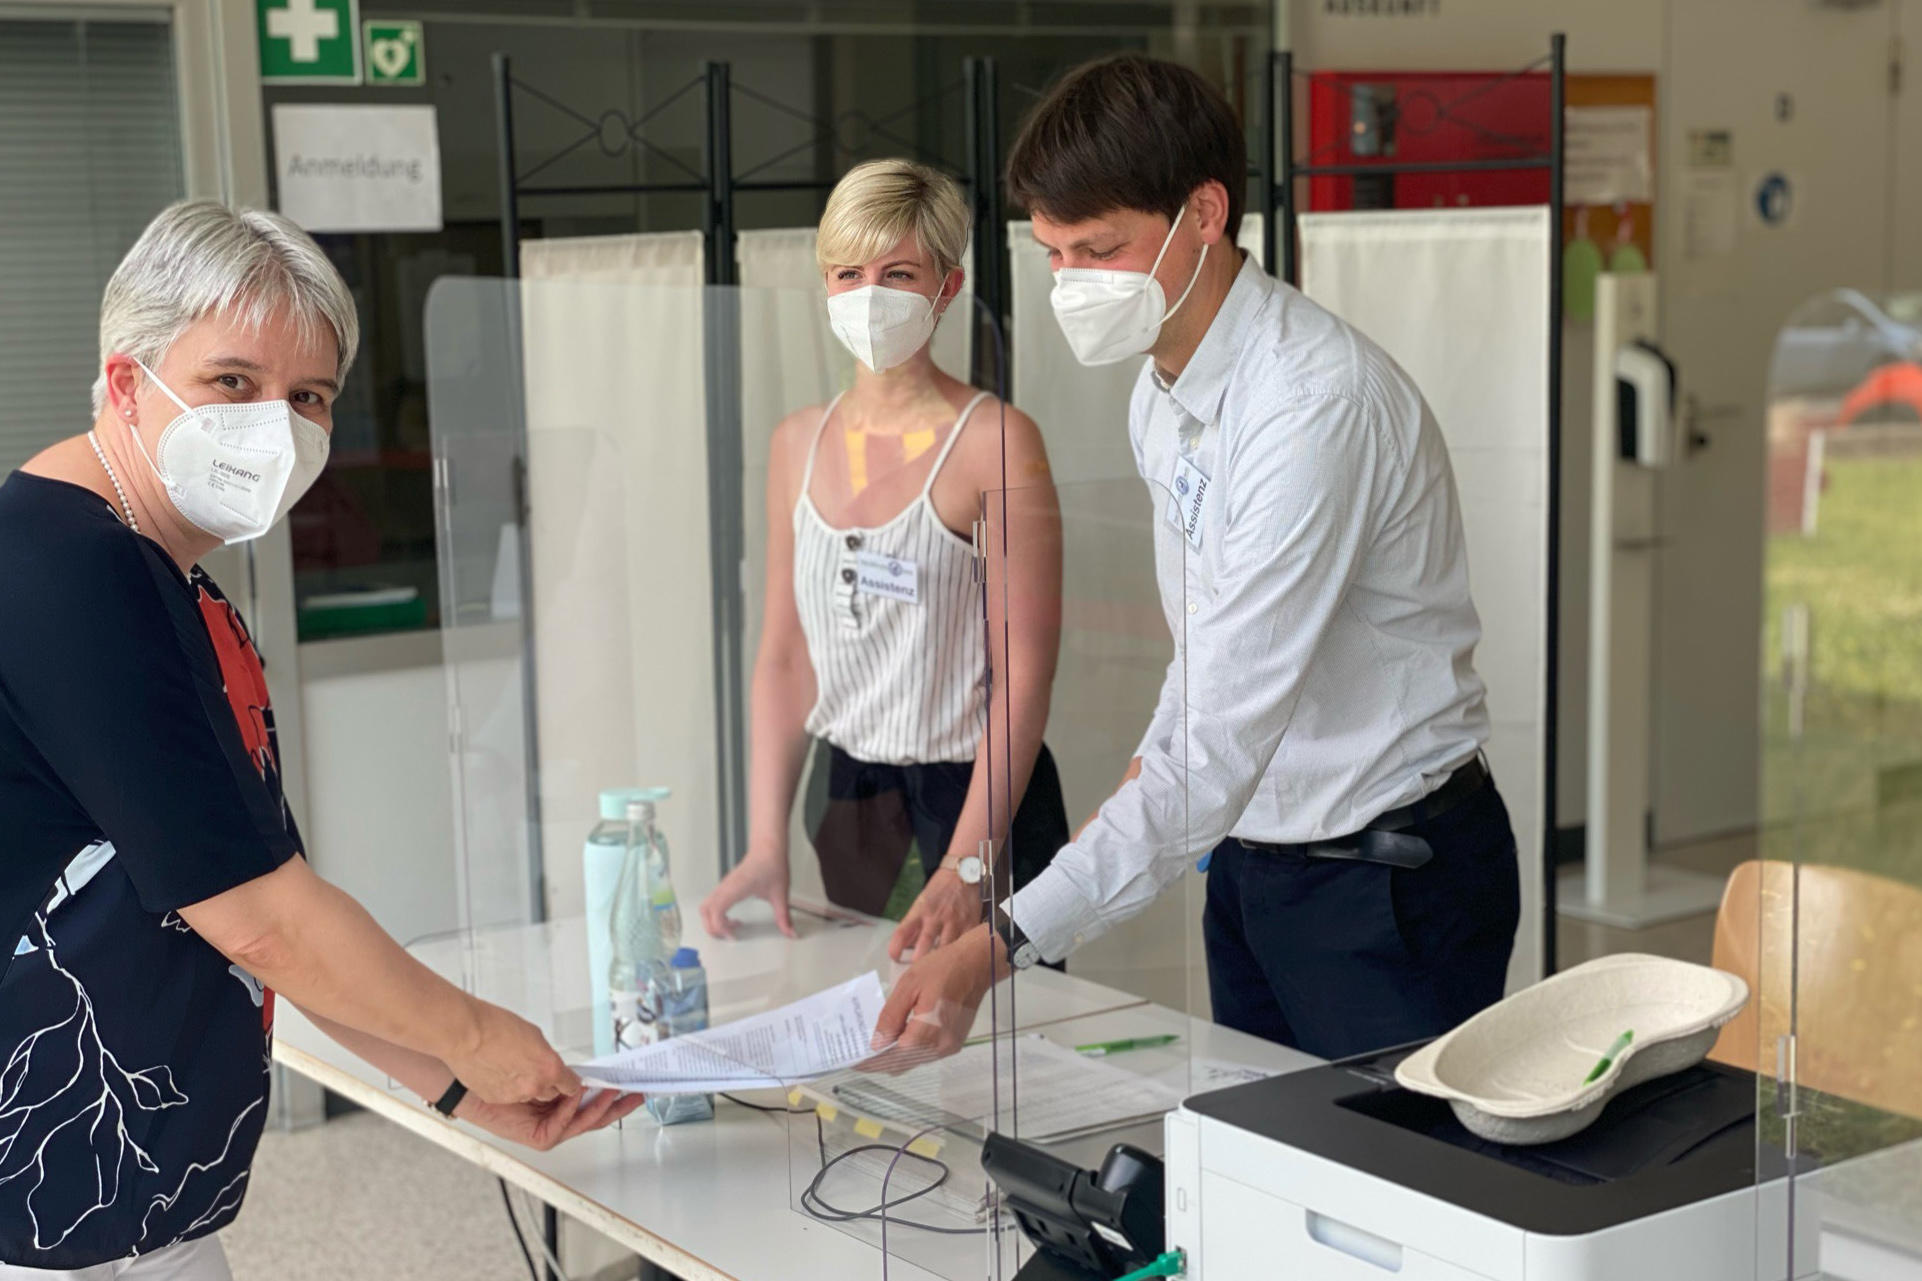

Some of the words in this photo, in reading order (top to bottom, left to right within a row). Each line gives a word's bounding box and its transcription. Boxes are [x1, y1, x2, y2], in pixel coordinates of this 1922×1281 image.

[287, 154, 422, 184] Anmeldung
[1185, 478, 1207, 540] Assistenz
[861, 576, 914, 597] Assistenz
